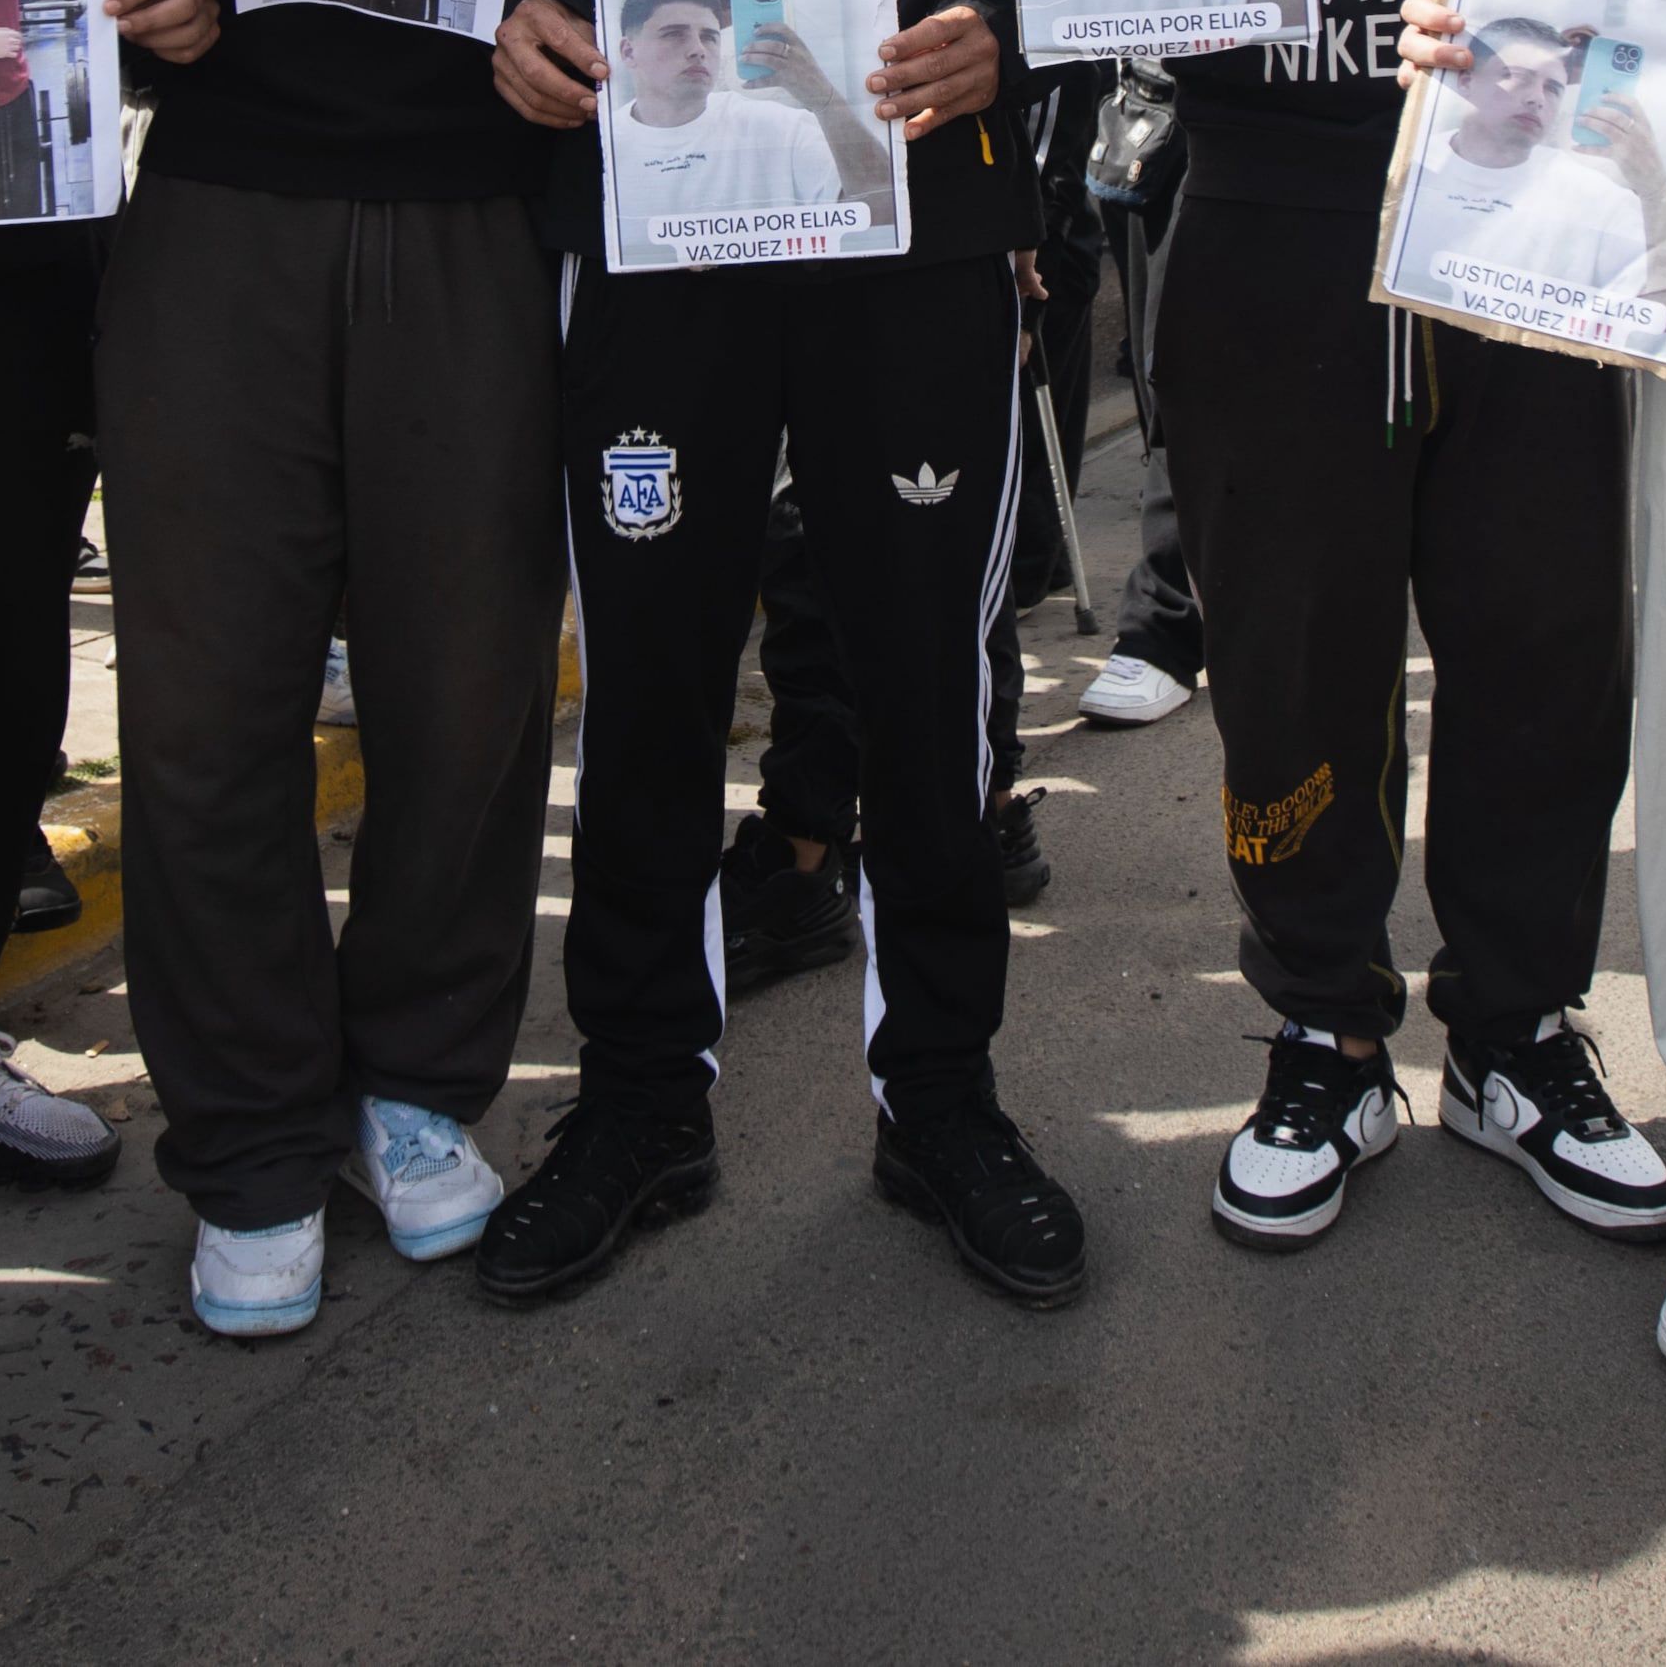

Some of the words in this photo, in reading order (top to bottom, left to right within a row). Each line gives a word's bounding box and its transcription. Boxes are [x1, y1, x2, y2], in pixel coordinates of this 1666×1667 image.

[1061, 17, 1155, 40] JUSTICIA
[1160, 14, 1203, 34] POR
[1209, 10, 1267, 31] ELIAS
[657, 216, 749, 239] JUSTICIA
[754, 213, 796, 233] POR
[800, 209, 858, 230] ELIAS
[686, 239, 783, 262] VAZQUEZ
[1438, 259, 1536, 298] JUSTICIA
[1540, 282, 1587, 309] POR
[1591, 294, 1653, 326] ELIAS
[1463, 290, 1565, 332] VAZQUEZ
[618, 472, 665, 516] AFA
